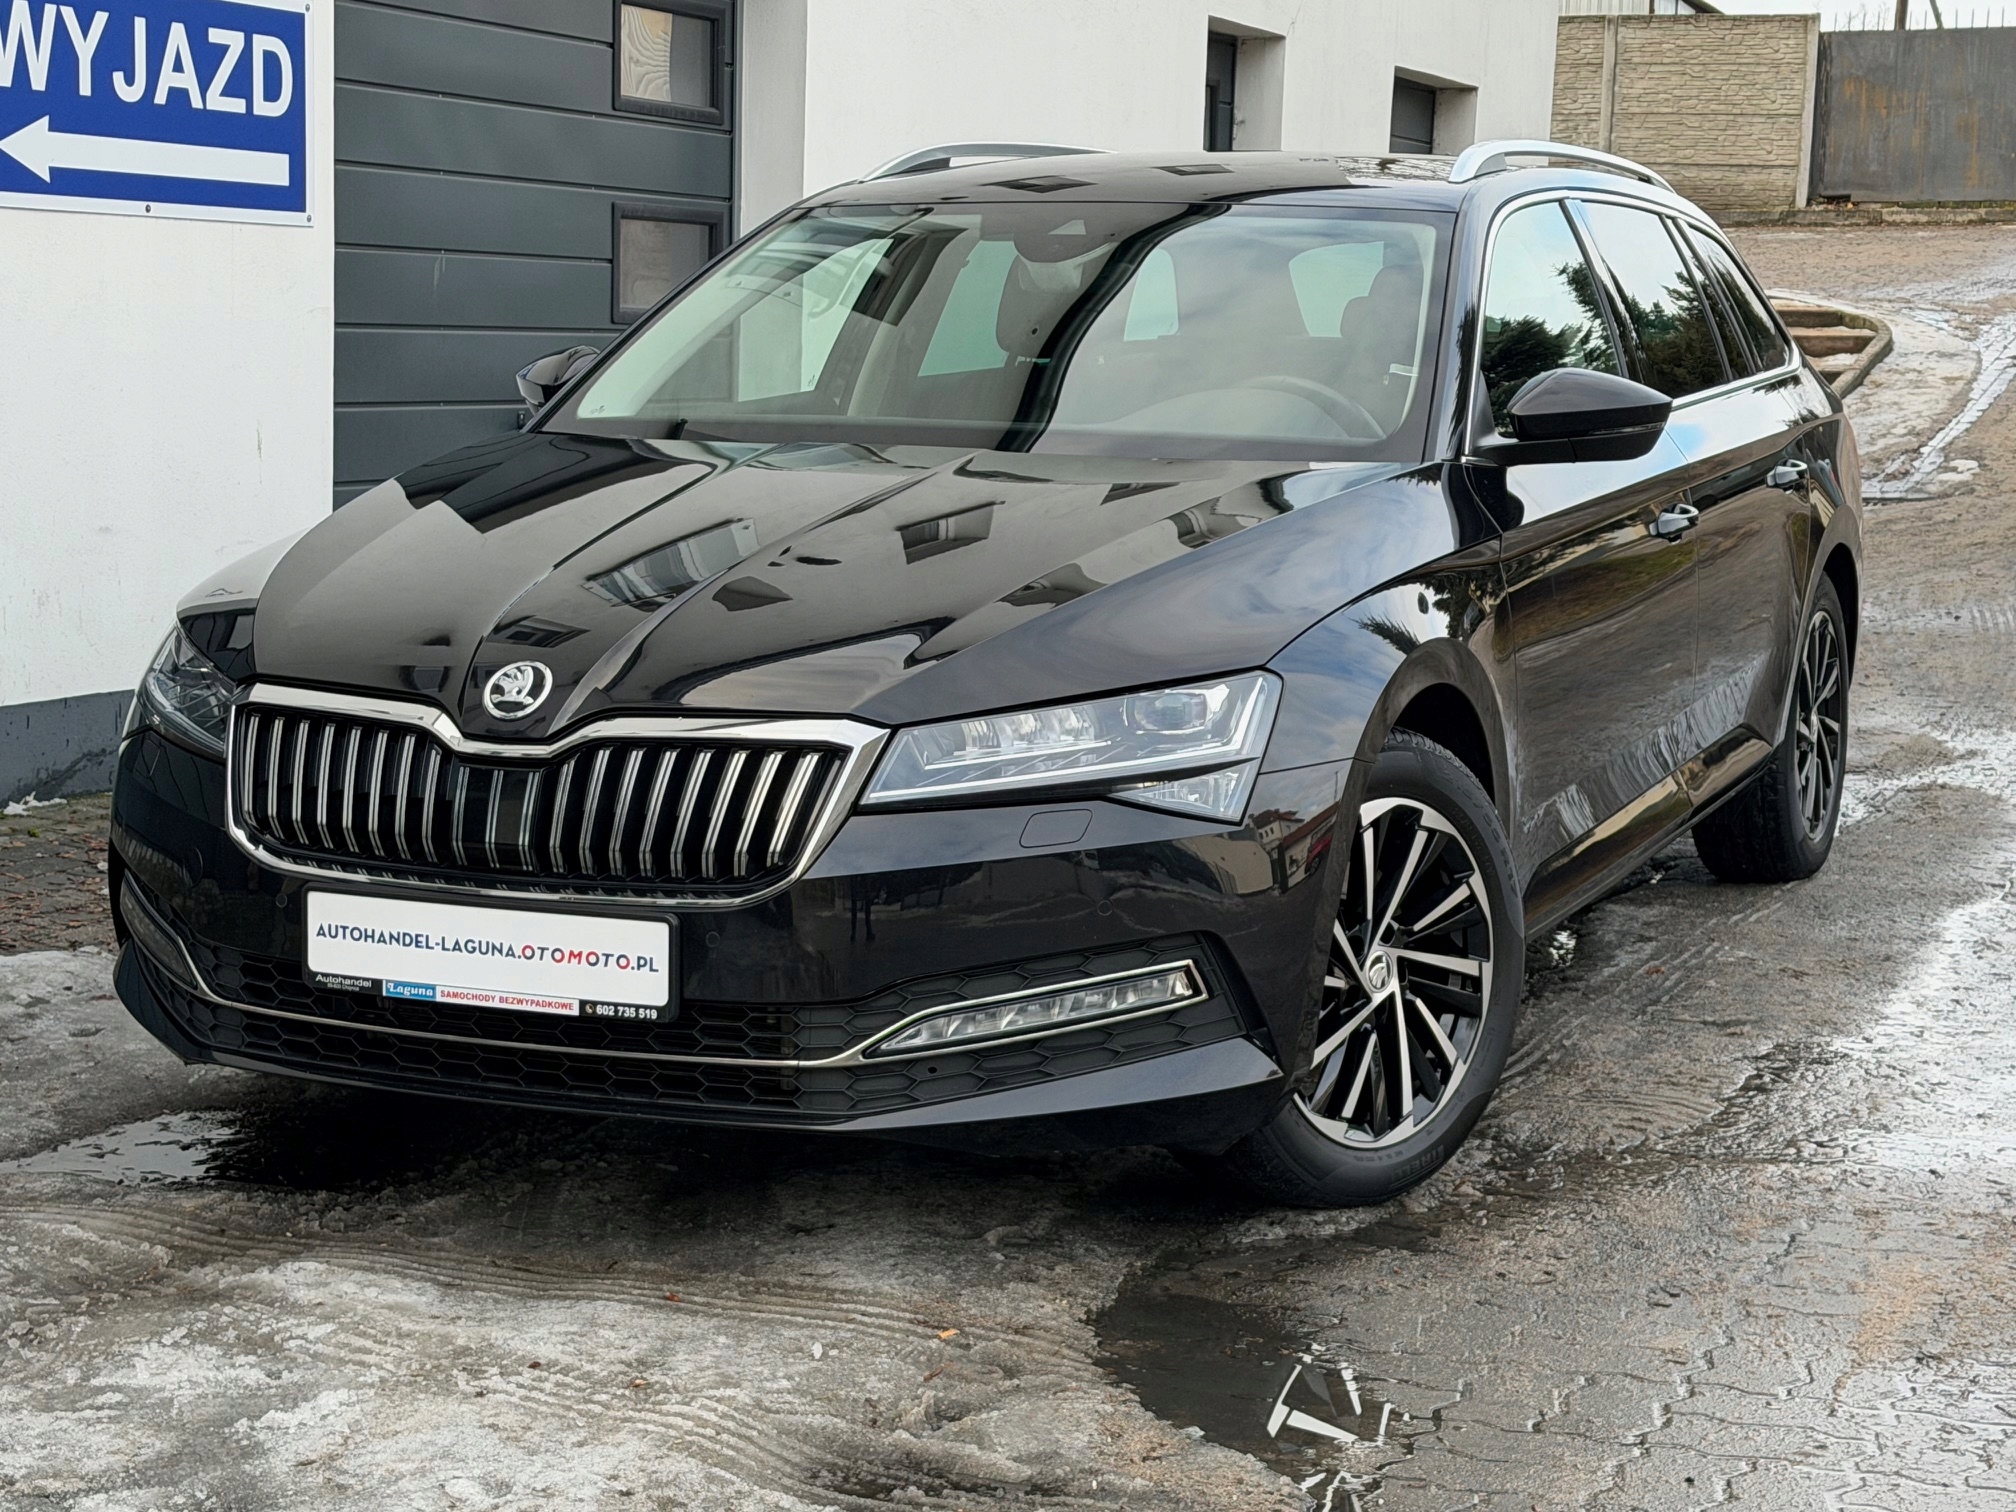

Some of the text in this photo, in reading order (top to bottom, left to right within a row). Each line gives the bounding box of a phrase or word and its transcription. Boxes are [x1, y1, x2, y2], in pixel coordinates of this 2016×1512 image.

[0, 0, 293, 117] WYJAZD
[315, 922, 659, 973] AUTOHANDEL-LAGUNA.OTOMOTO.PL
[315, 973, 372, 988] Autohandel
[387, 983, 434, 997] Laguna
[440, 989, 496, 1004] SAMOCHODY
[498, 995, 574, 1011] BEZWYPADKOWE
[596, 1004, 615, 1016] 602
[617, 1006, 636, 1018] 735
[638, 1008, 658, 1020] 519
